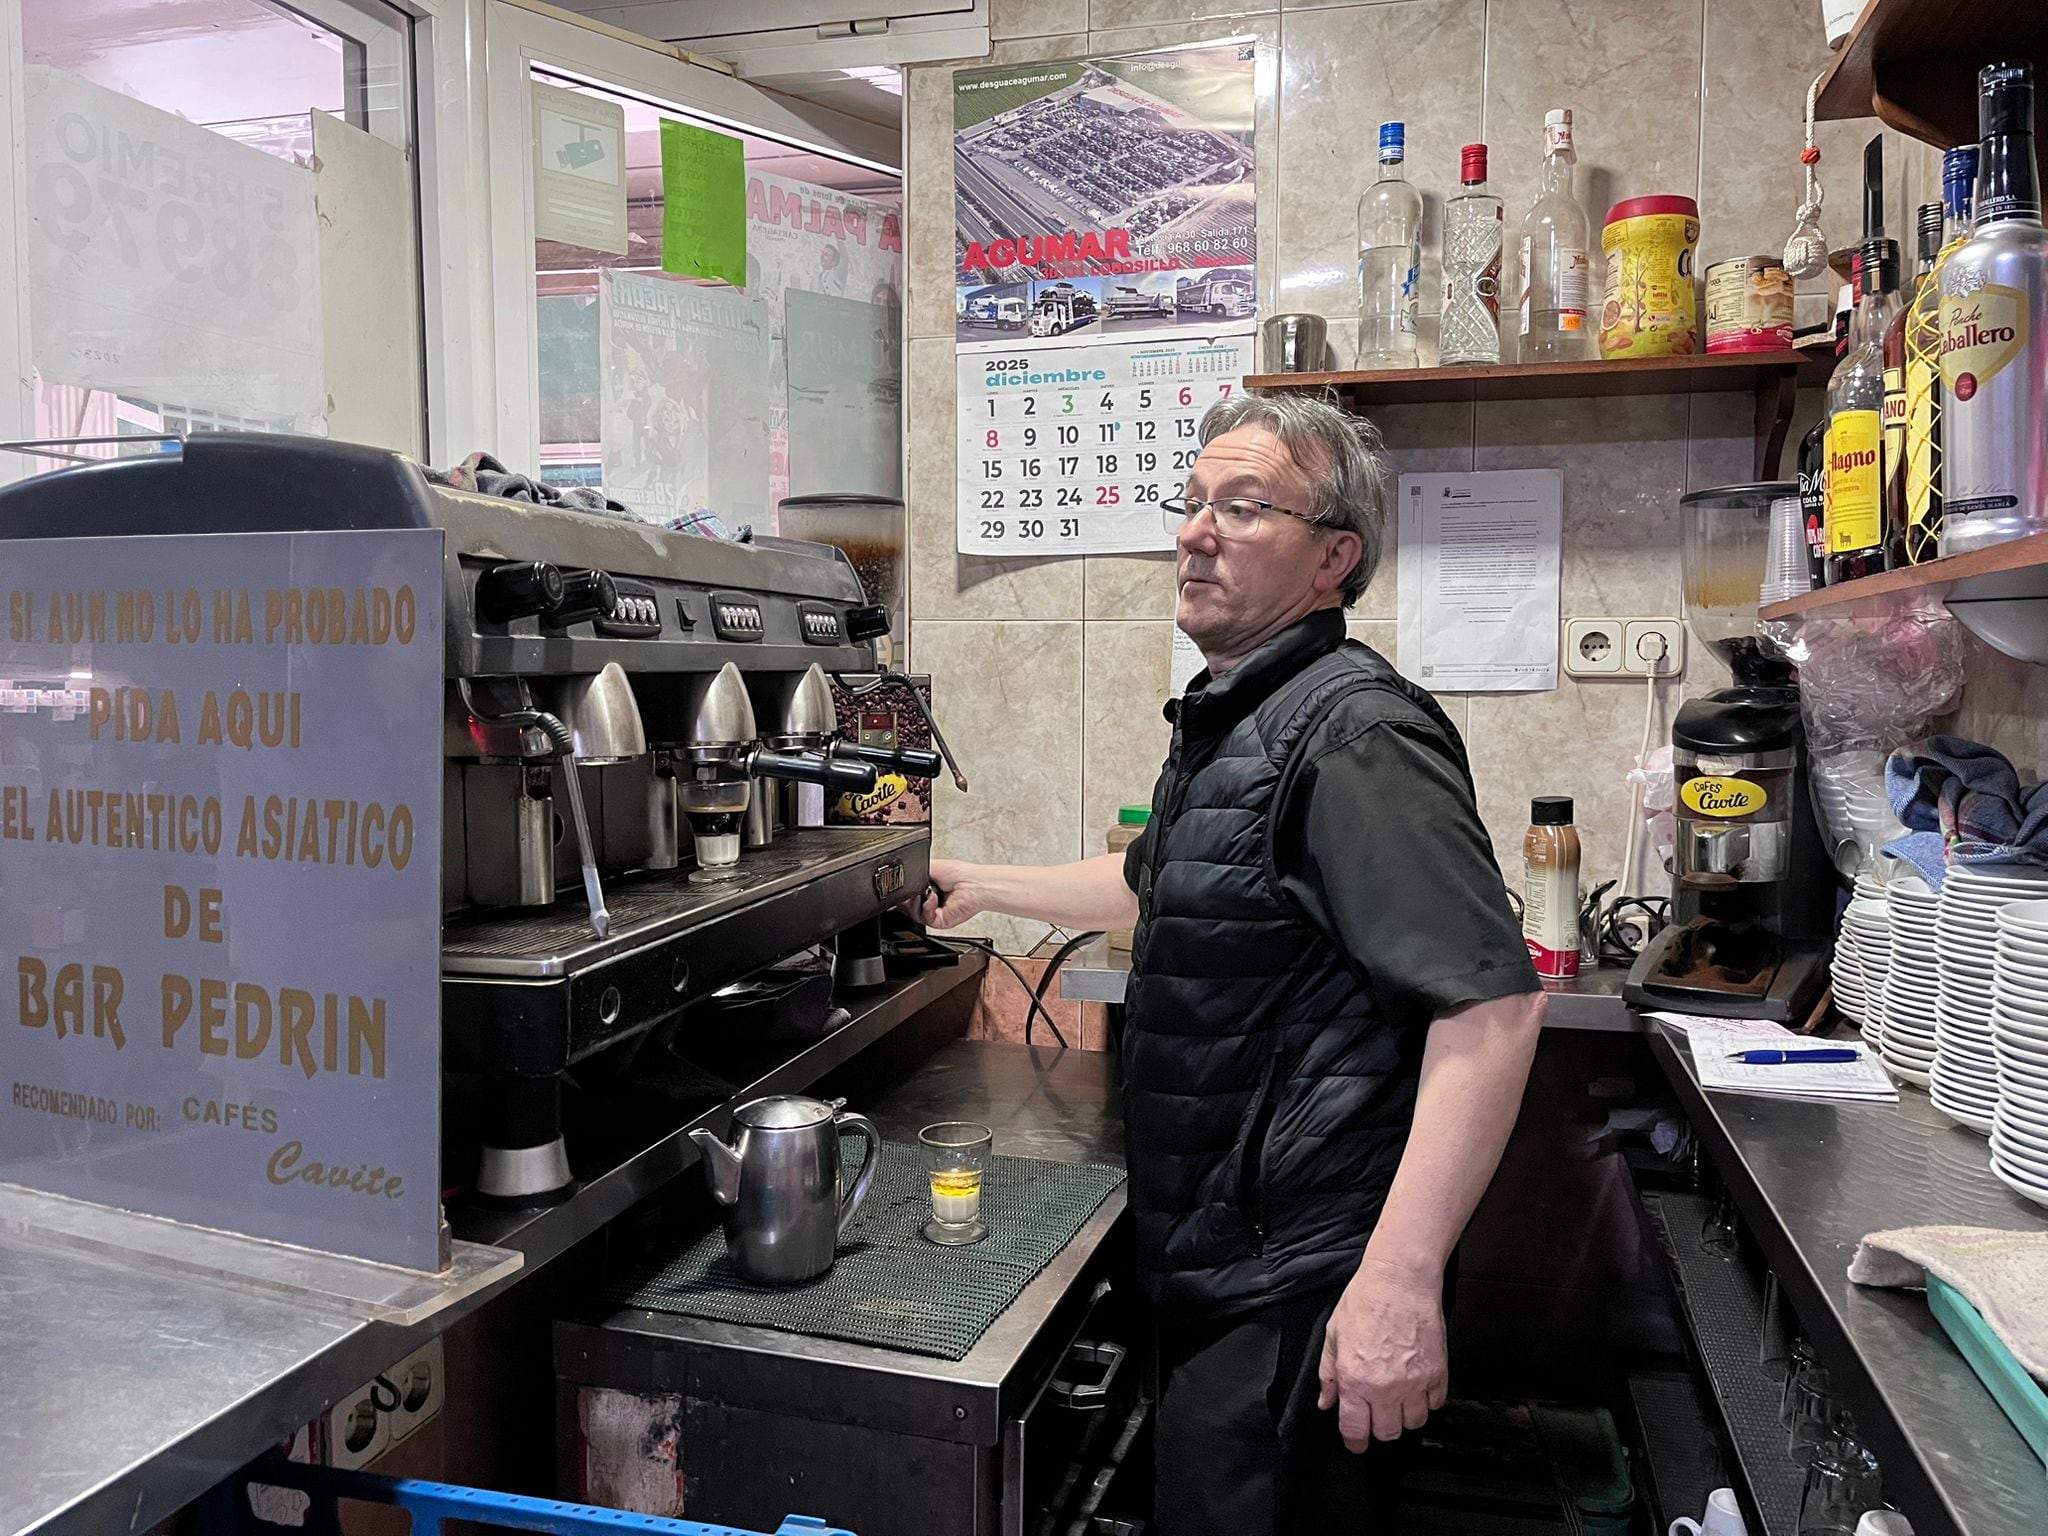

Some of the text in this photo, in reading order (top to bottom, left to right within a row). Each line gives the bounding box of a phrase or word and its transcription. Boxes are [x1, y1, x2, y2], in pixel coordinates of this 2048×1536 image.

[958, 71, 1067, 91] www.desguaceagumar.com
[963, 229, 1132, 274] AGUMAR
[1168, 242, 1191, 255] 968
[1194, 240, 1209, 252] 60
[1213, 238, 1228, 251] 82
[1232, 237, 1248, 249] 60
[985, 358, 1029, 372] 2025
[985, 368, 1106, 387] diciembre
[987, 399, 996, 418] 1
[1023, 397, 1036, 416] 2
[1061, 394, 1074, 414] 3
[1100, 392, 1114, 411] 4
[1139, 390, 1152, 408] 5
[1178, 386, 1192, 406] 6
[986, 418, 1196, 448] 8 9 10 11 12 13
[982, 450, 1196, 479] 15 16 17 18 19 20
[980, 482, 1186, 509] 22 23 24 25 26 2
[1803, 496, 1817, 504] COLD
[980, 518, 1079, 539] 29 30 31
[48, 591, 105, 643] AUN
[116, 590, 155, 643] NO
[165, 588, 202, 645] LO
[213, 589, 253, 645] HA
[265, 584, 417, 646] PROBADO
[89, 687, 302, 751] PIDA AQUI
[851, 782, 896, 814] Cavite
[1699, 792, 1749, 810] Cavite
[2, 786, 413, 872] EL AUTENTICO ASIATICO
[164, 884, 224, 943] DE
[17, 956, 386, 1079] BAR PEDRIN
[12, 1081, 162, 1132] RECOMENDADO POR:
[181, 1097, 279, 1133] CAFÉS
[266, 1140, 406, 1200] Cavite
